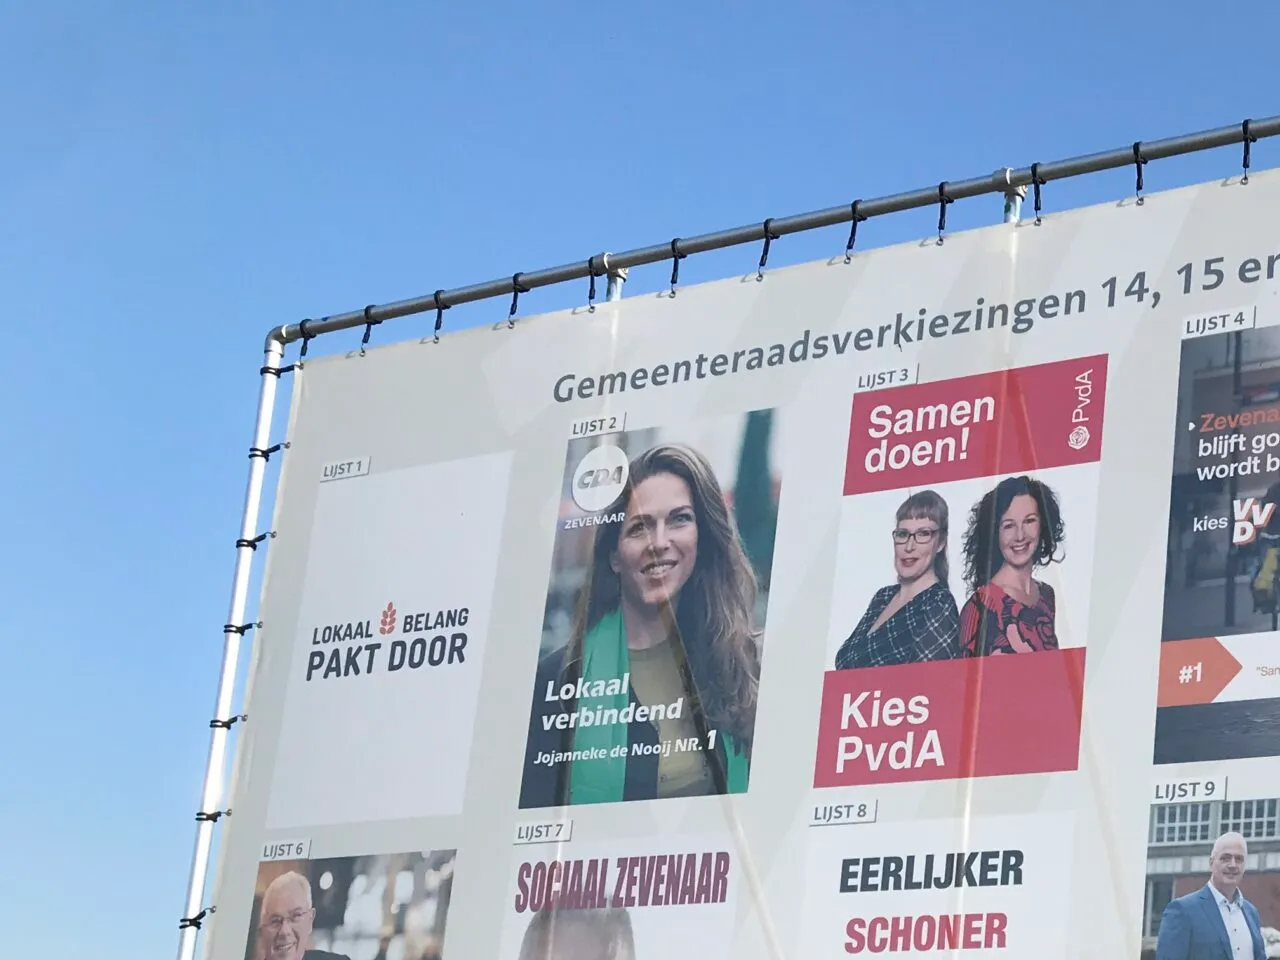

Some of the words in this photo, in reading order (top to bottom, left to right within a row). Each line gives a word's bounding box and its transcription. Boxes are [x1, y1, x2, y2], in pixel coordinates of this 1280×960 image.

[554, 288, 1086, 403] Gemeenteraadsverkiezingen
[1101, 271, 1161, 308] 14,
[1177, 257, 1225, 294] 15
[1186, 314, 1230, 334] LIJST
[1234, 311, 1245, 326] 4
[858, 371, 899, 389] LIJST
[900, 369, 909, 382] 3
[1071, 368, 1093, 423] PvdA
[572, 419, 603, 437] LIJST
[608, 417, 617, 430] 2
[868, 396, 995, 438] Samen
[864, 429, 970, 473] doen!
[1198, 433, 1246, 458] blijft
[323, 461, 354, 478] LIJST
[356, 461, 362, 472] 1
[576, 465, 624, 490] CDA
[1196, 456, 1260, 481] wordt
[564, 512, 625, 529] ZEVENAAR
[1193, 515, 1228, 532] kies
[1232, 498, 1277, 545] VVD
[312, 620, 373, 645] LOKAAL
[402, 608, 469, 634] BELANG
[306, 642, 380, 682] PAKT
[388, 632, 467, 673] DOOR
[1179, 662, 1202, 683] #1
[544, 673, 630, 703] Lokaal
[541, 699, 683, 731] verbindend
[840, 690, 929, 730] Kies
[533, 746, 606, 766] Jojanneke
[610, 743, 628, 758] de
[631, 738, 671, 758] Nooij
[675, 736, 703, 752] NR.
[706, 730, 717, 750] 1
[836, 729, 945, 773] PvdA
[1155, 782, 1201, 801] LIJST
[1205, 781, 1215, 796] 9
[814, 805, 853, 822] LIJST
[857, 804, 867, 818] 8
[518, 825, 552, 841] LIJST
[554, 824, 563, 837] 7
[263, 844, 293, 858] LIJST
[295, 842, 303, 855] 6
[515, 858, 609, 913] SOCIAAL
[612, 852, 730, 908] ZEVENAAR
[839, 850, 1024, 893] EERLIJKER
[844, 912, 1008, 954] SCHONER
